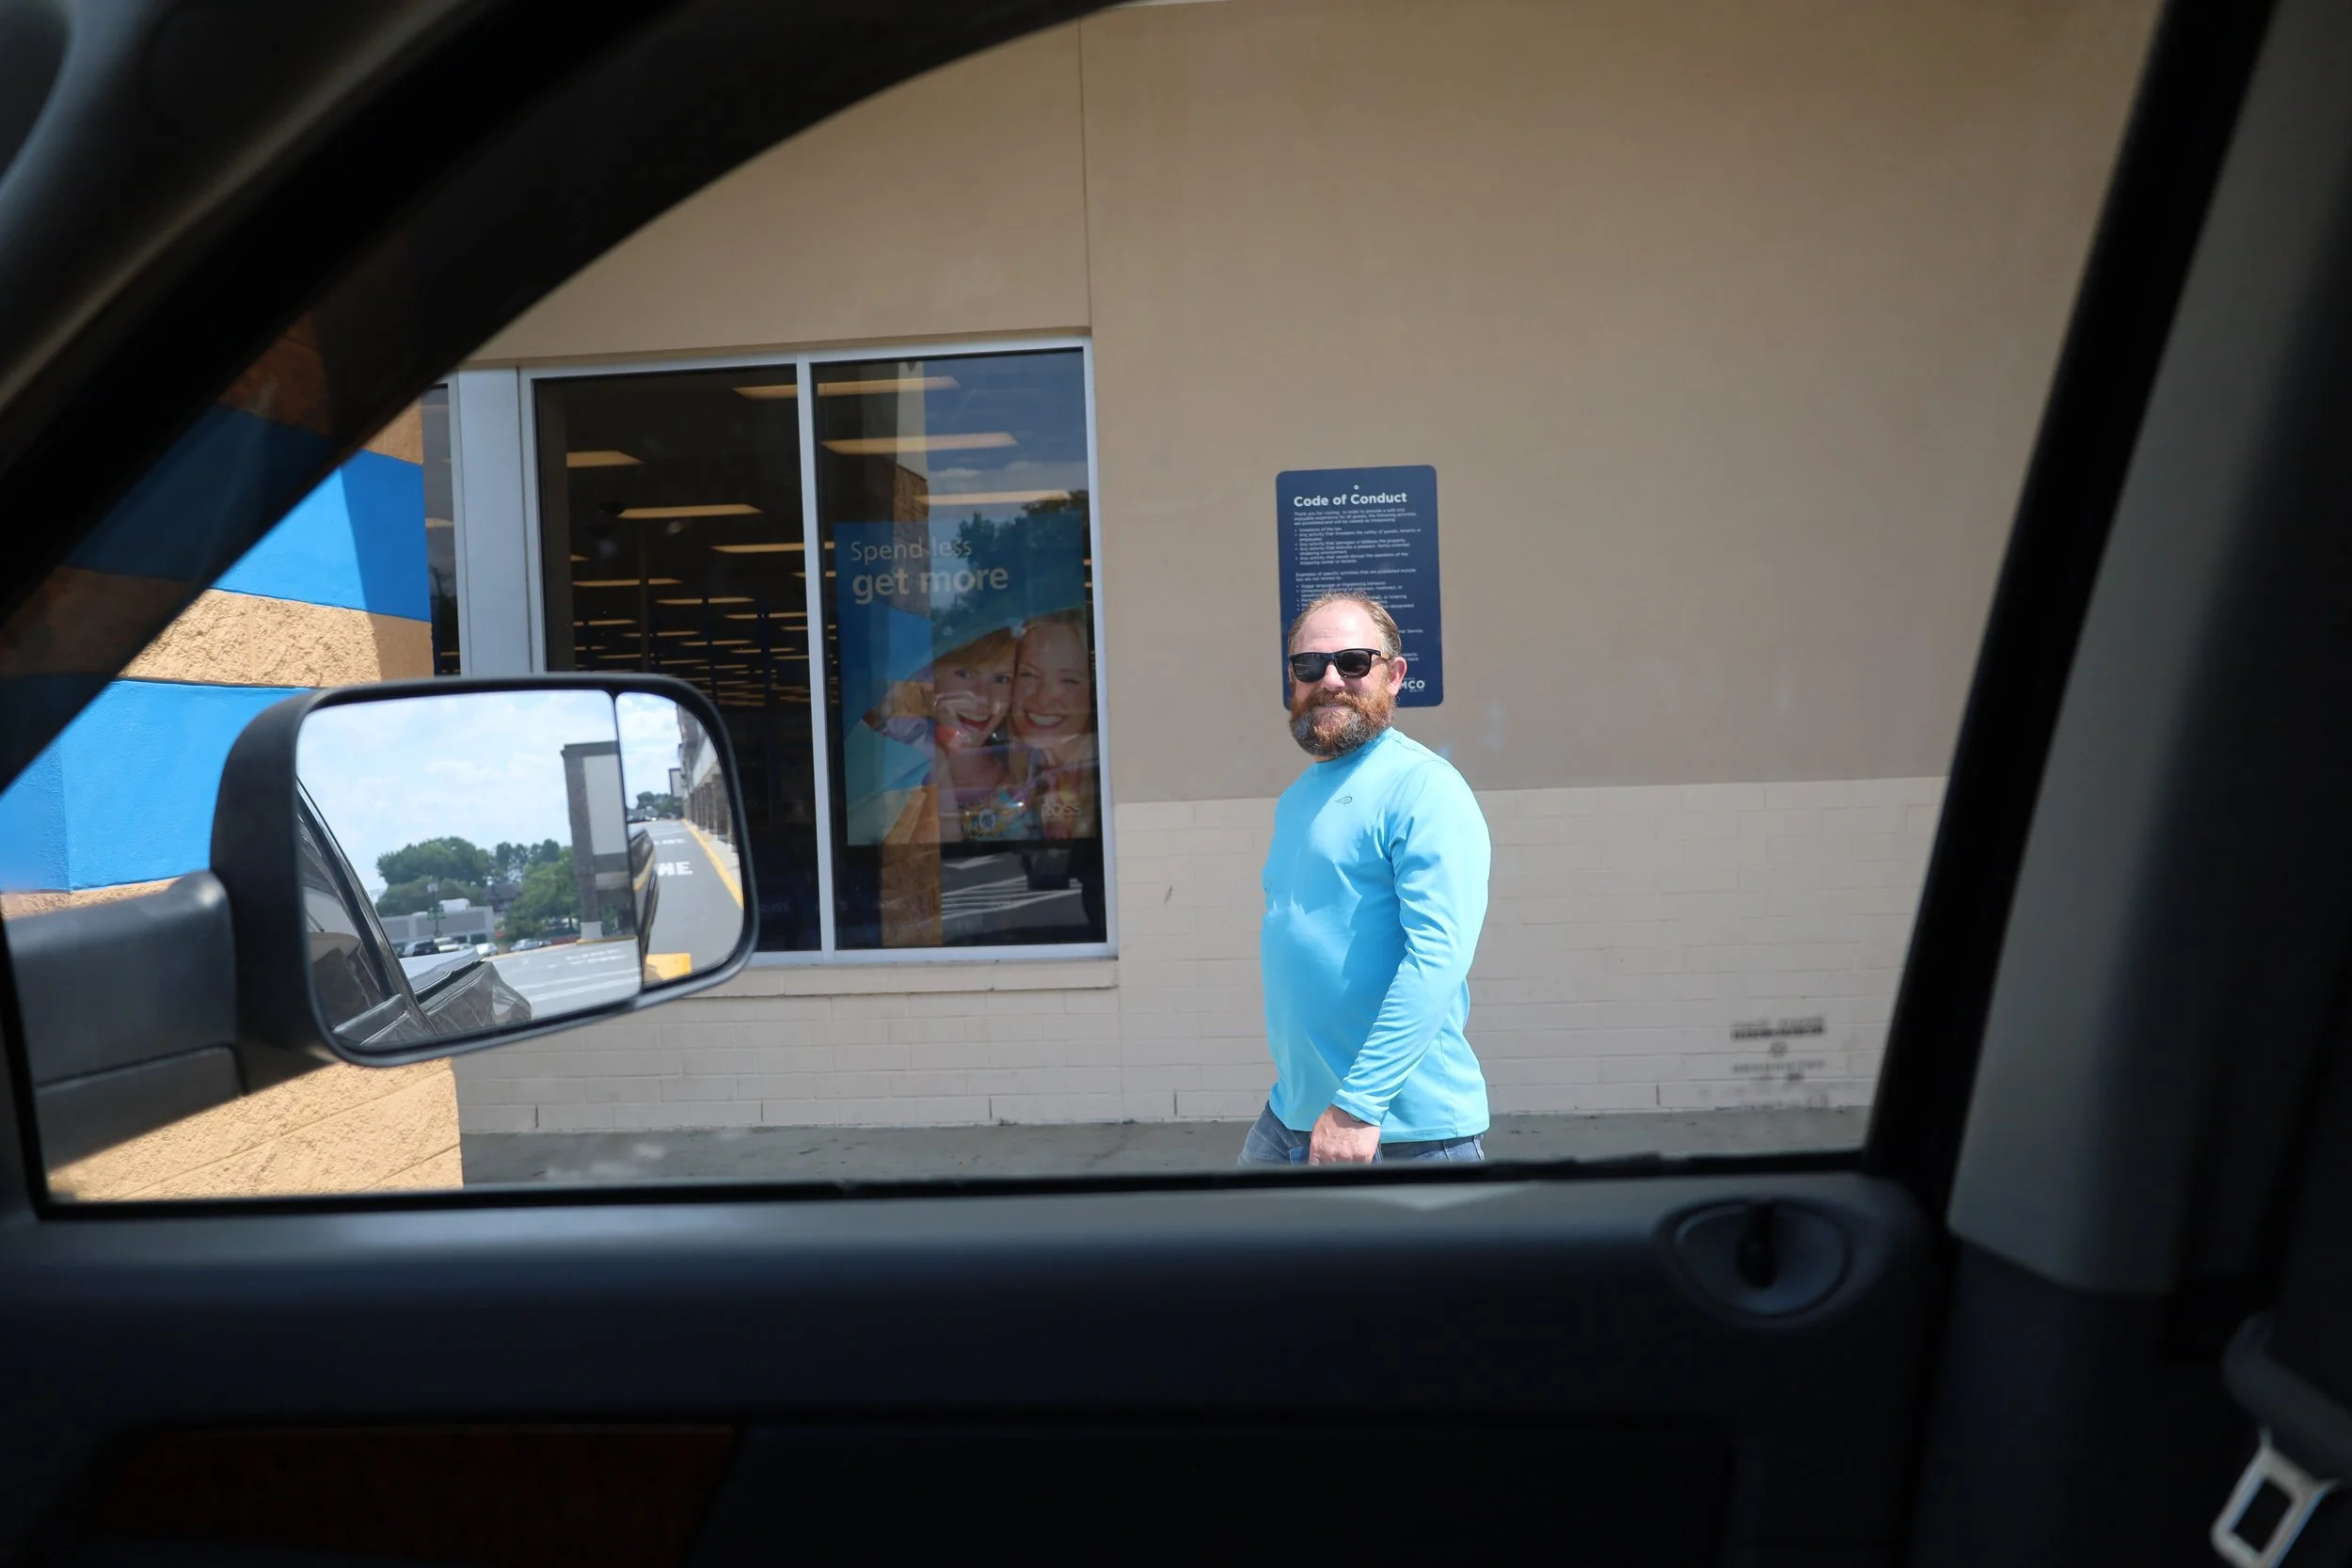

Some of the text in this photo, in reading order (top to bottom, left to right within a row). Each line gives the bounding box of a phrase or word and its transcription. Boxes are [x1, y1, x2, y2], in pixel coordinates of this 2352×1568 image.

[1294, 492, 1407, 507] Code of Conduct
[850, 536, 973, 564] Spend less
[851, 567, 1009, 605] get more
[1399, 680, 1425, 689] MCO
